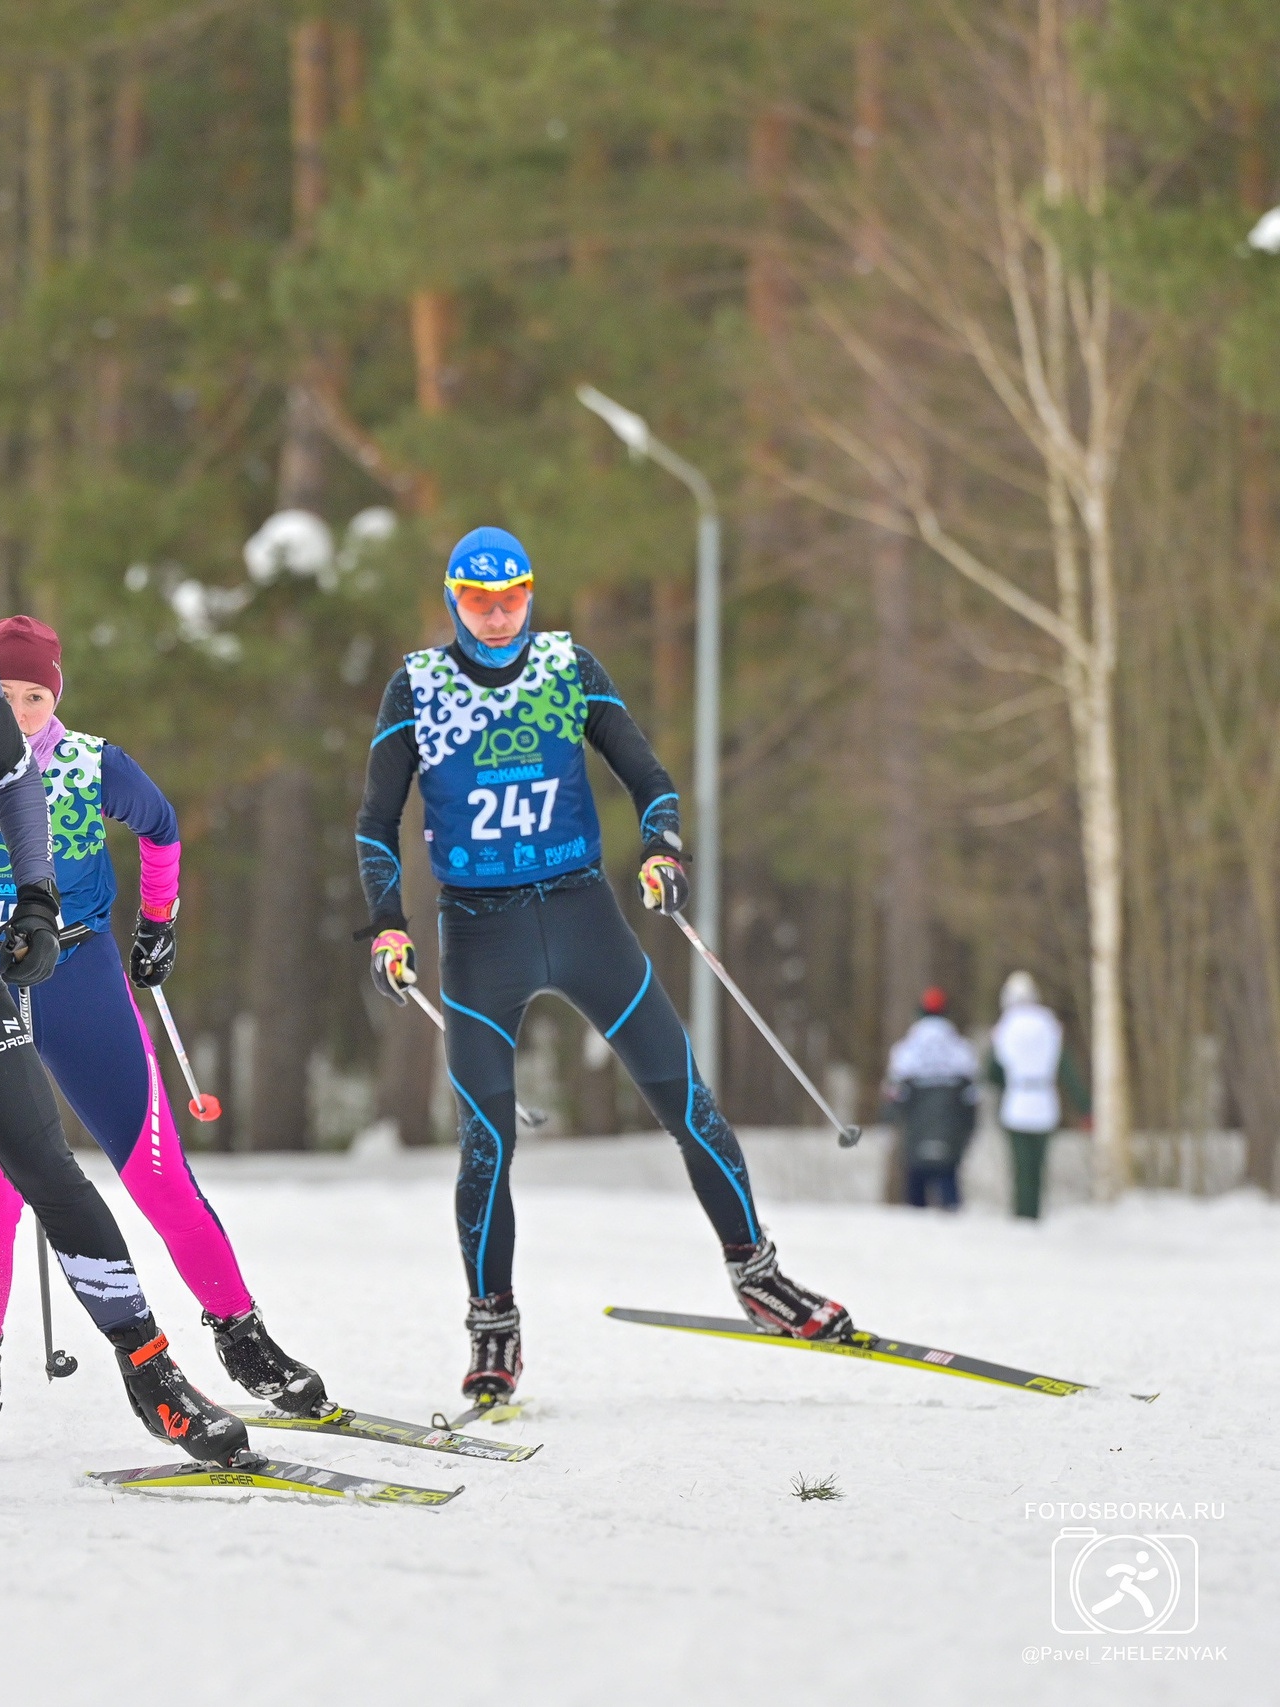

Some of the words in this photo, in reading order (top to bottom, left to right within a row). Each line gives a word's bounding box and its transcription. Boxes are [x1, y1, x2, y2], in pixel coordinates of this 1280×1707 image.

[473, 725, 539, 768] 400
[498, 763, 544, 781] KAMAZ
[467, 778, 559, 840] 247
[209, 1474, 255, 1485] FISCHER
